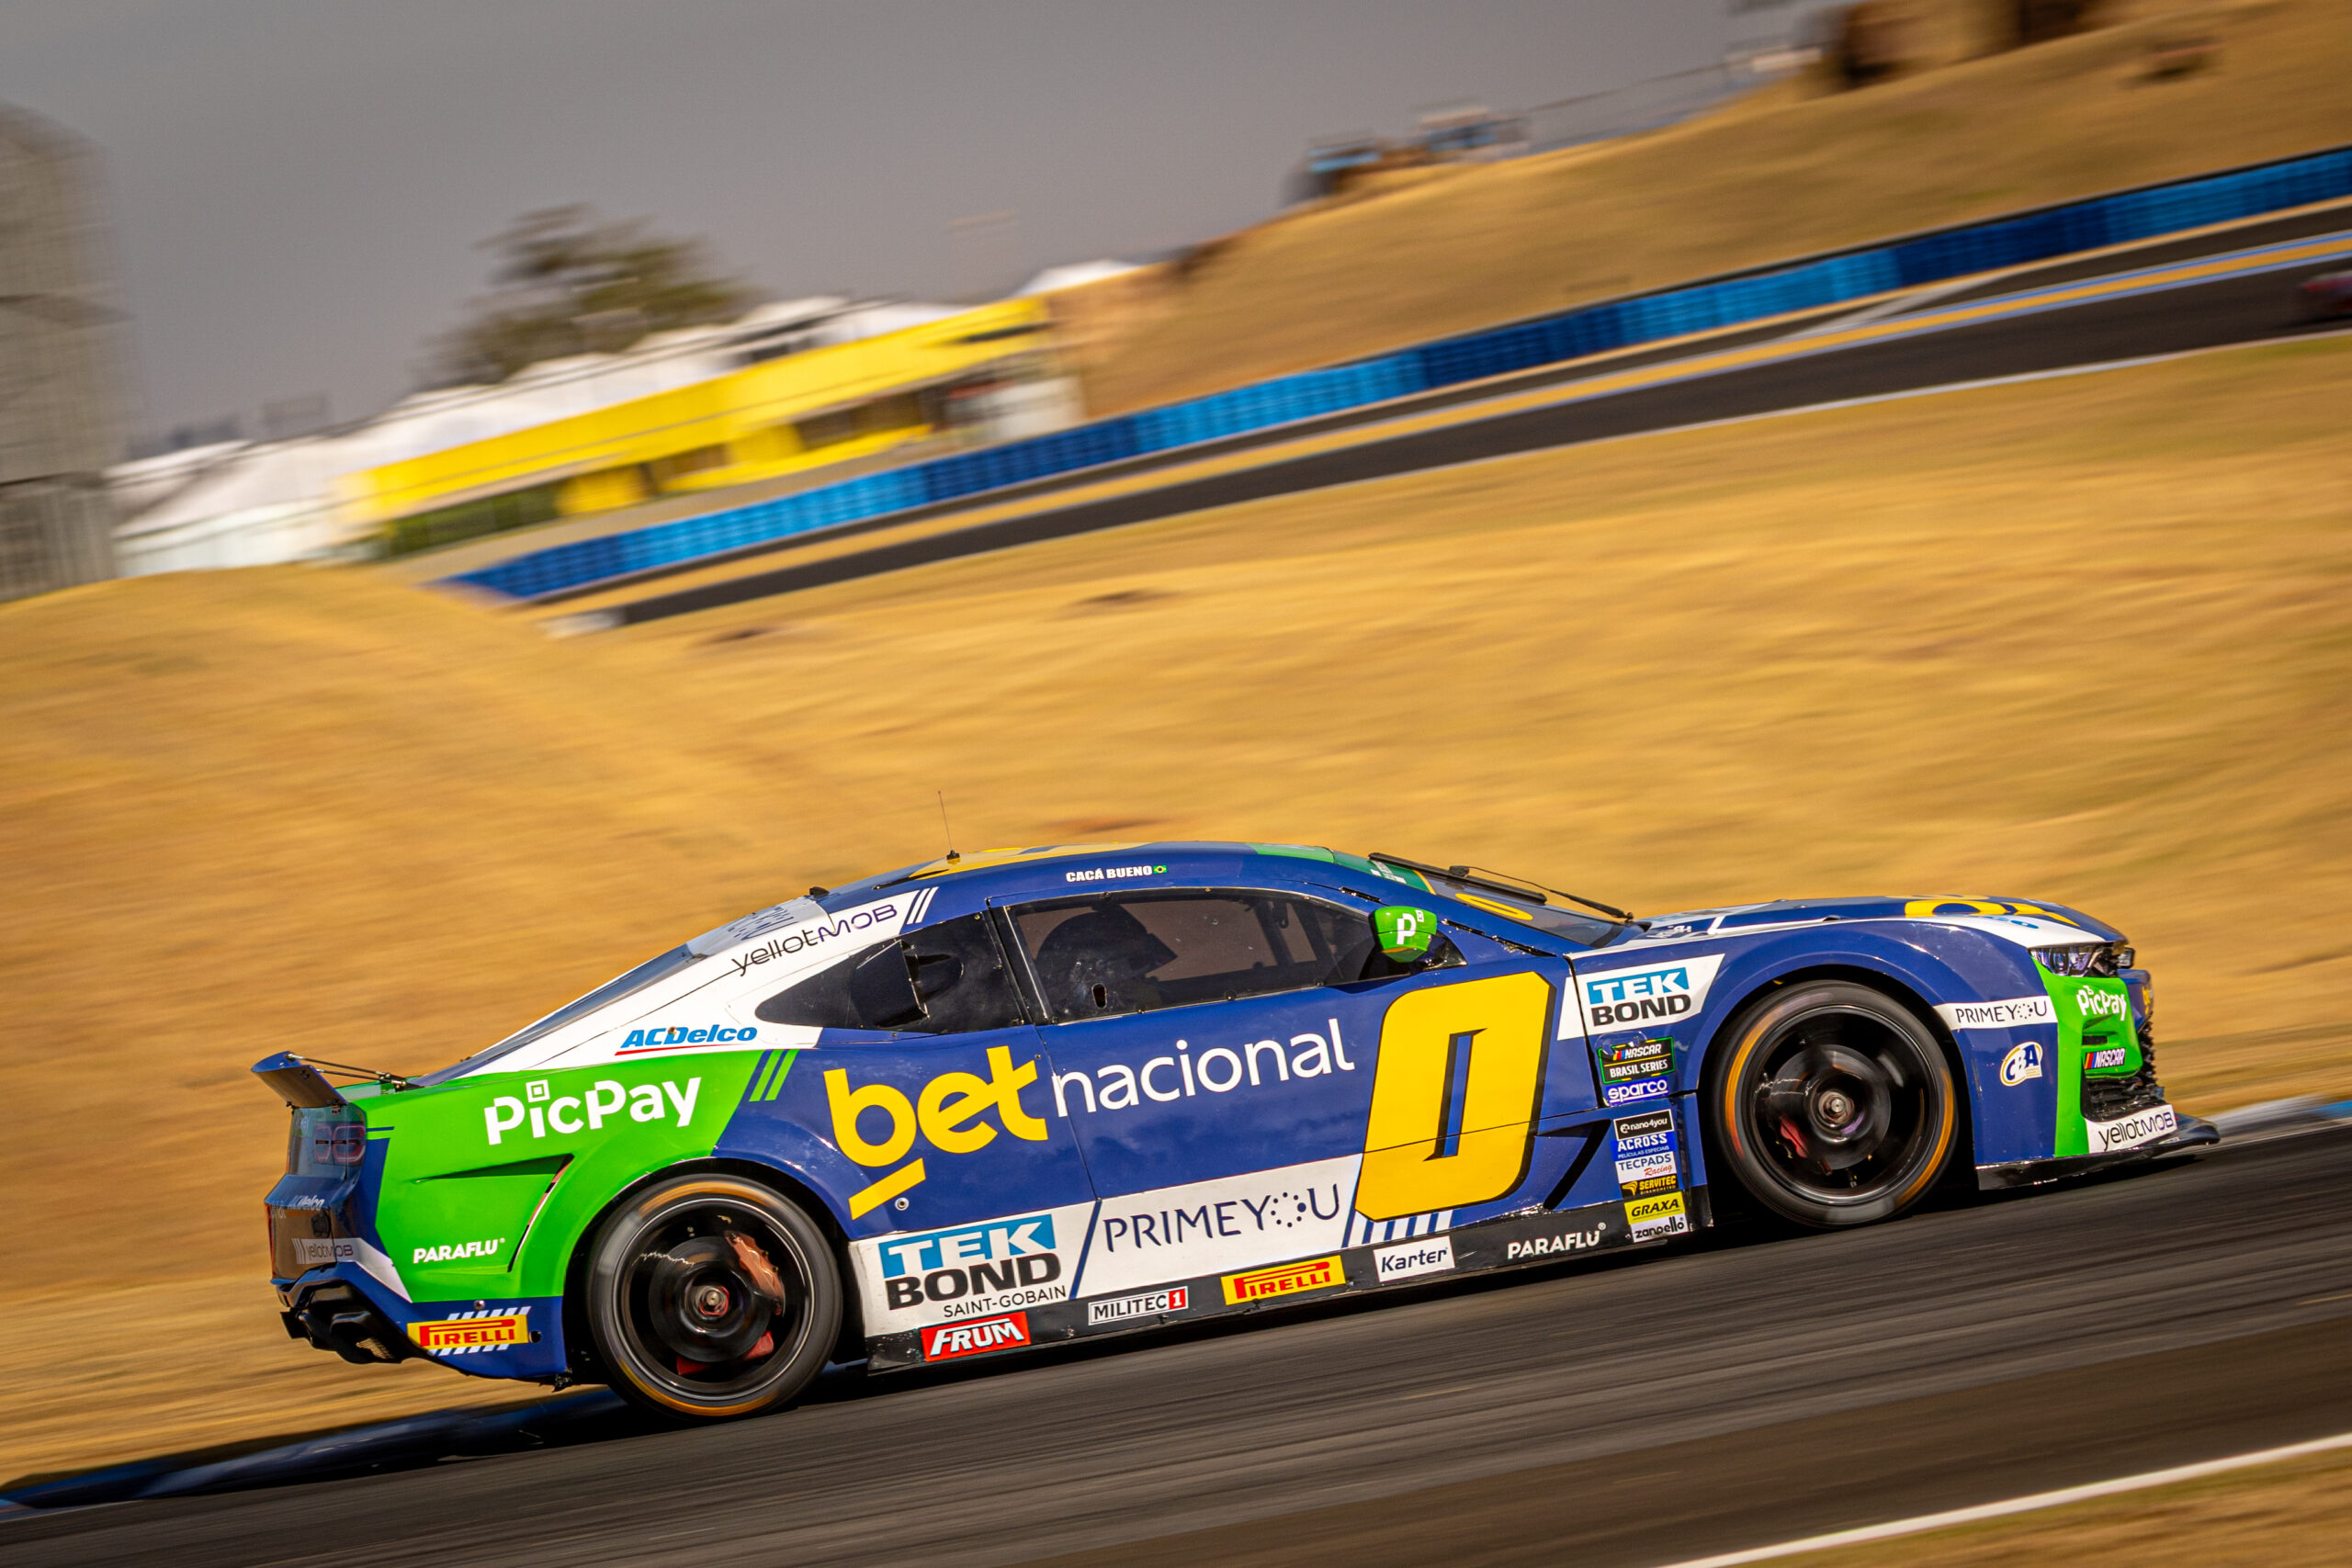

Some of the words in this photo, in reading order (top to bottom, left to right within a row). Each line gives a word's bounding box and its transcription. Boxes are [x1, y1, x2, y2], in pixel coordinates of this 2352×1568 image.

[1066, 868, 1104, 882] CACÁ
[1106, 865, 1152, 879] BUENO
[731, 904, 898, 976] yellotMOB
[1590, 969, 1688, 1004] TEK
[1592, 994, 1692, 1027] BOND
[2076, 985, 2127, 1021] PicPay
[620, 1024, 758, 1048] ACDelco
[1624, 1043, 1662, 1059] NASCAR
[2006, 1043, 2040, 1081] CBA
[2094, 1047, 2126, 1068] NASCAR
[1610, 1065, 1640, 1078] BRASIL
[1641, 1059, 1668, 1073] SERIES
[1355, 971, 1555, 1222] 0
[1608, 1079, 1668, 1102] sparco
[483, 1077, 702, 1145] PicPay
[1630, 1118, 1668, 1131] nano4you
[1617, 1133, 1668, 1152] ACROSS
[2098, 1111, 2175, 1152] yellotMOB
[1619, 1154, 1671, 1171] TECPADS
[1644, 1165, 1673, 1178] Racing
[1639, 1176, 1676, 1190] SERVITEC
[1631, 1199, 1679, 1217] GRAXA
[886, 1220, 1053, 1277] TEK
[1381, 1249, 1447, 1272] Karter
[885, 1253, 1061, 1311] BOND
[1234, 1261, 1330, 1299] PIRELLI
[944, 1285, 1067, 1317] SAINT-GOBAIN
[419, 1319, 516, 1347] PIRELLI
[929, 1317, 1025, 1356] FRUM
